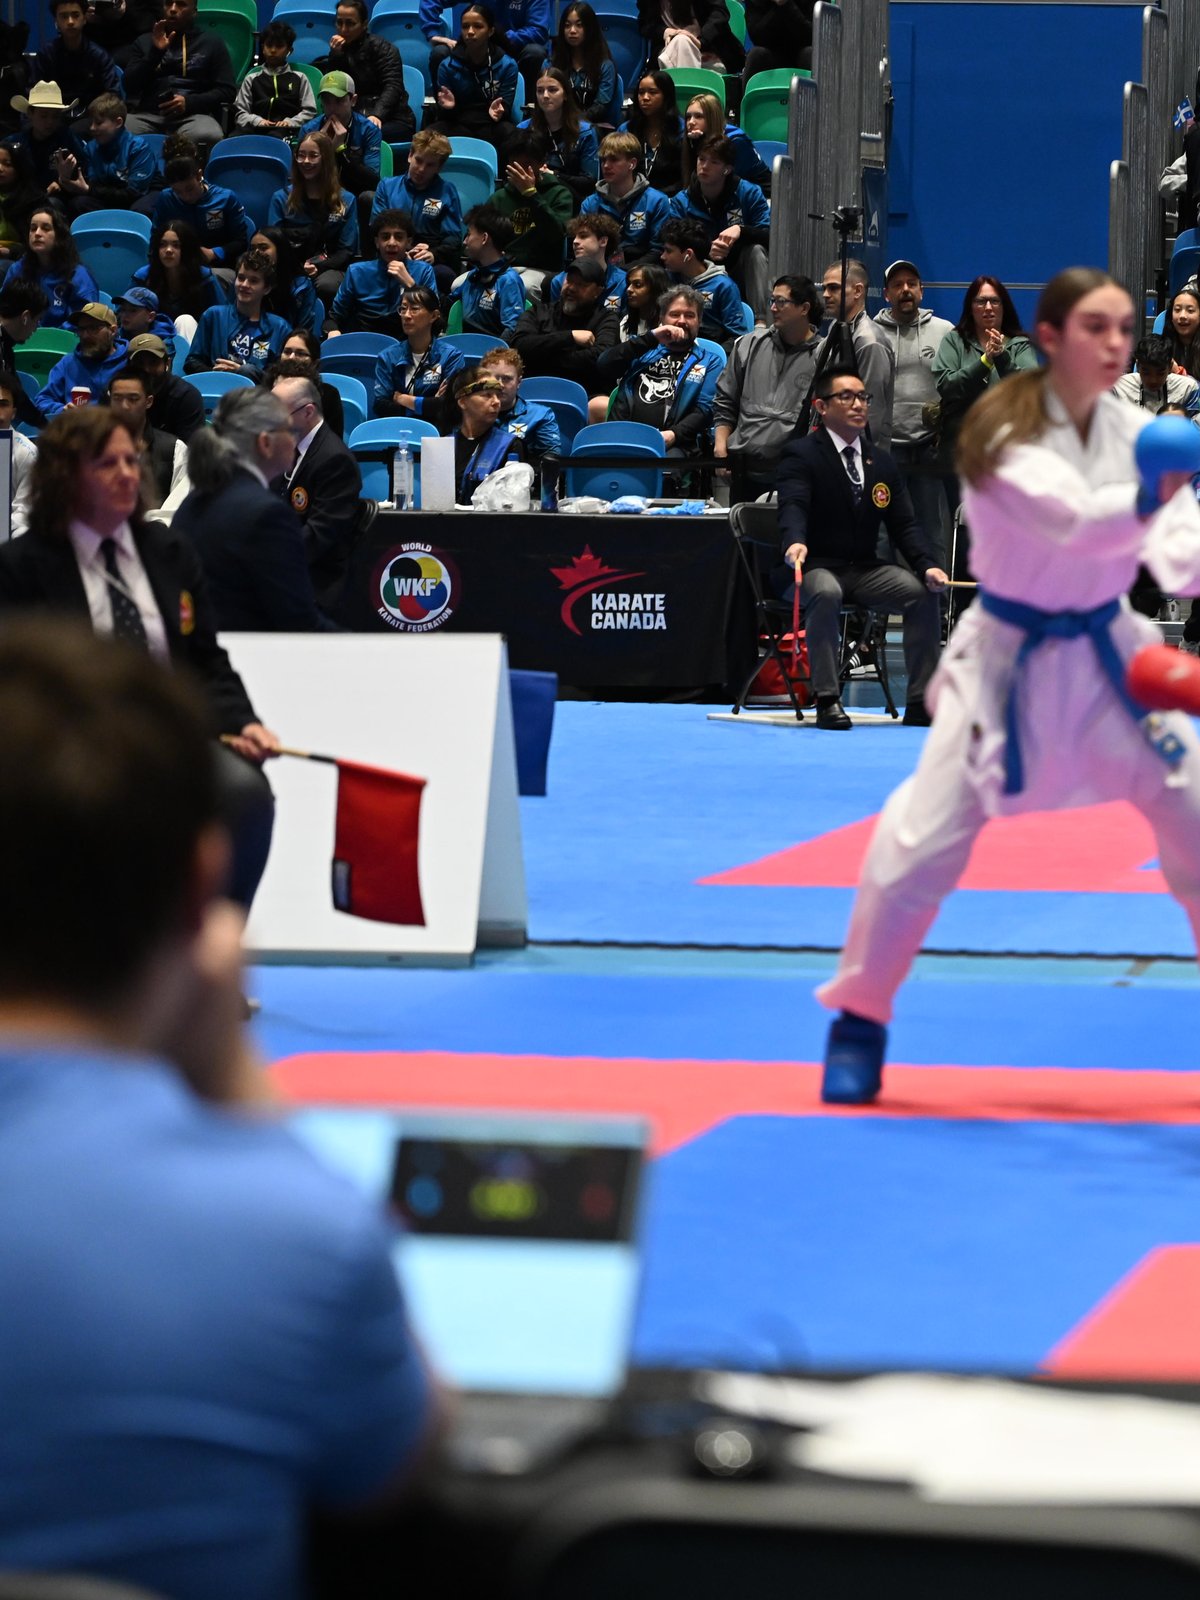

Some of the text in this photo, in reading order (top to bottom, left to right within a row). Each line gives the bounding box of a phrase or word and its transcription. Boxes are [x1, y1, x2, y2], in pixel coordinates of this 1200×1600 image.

[401, 542, 433, 553] WORLD
[393, 577, 437, 597] WKF
[591, 593, 666, 611] KARATE
[377, 606, 453, 632] KARATE FEDERATION
[591, 612, 667, 630] CANADA
